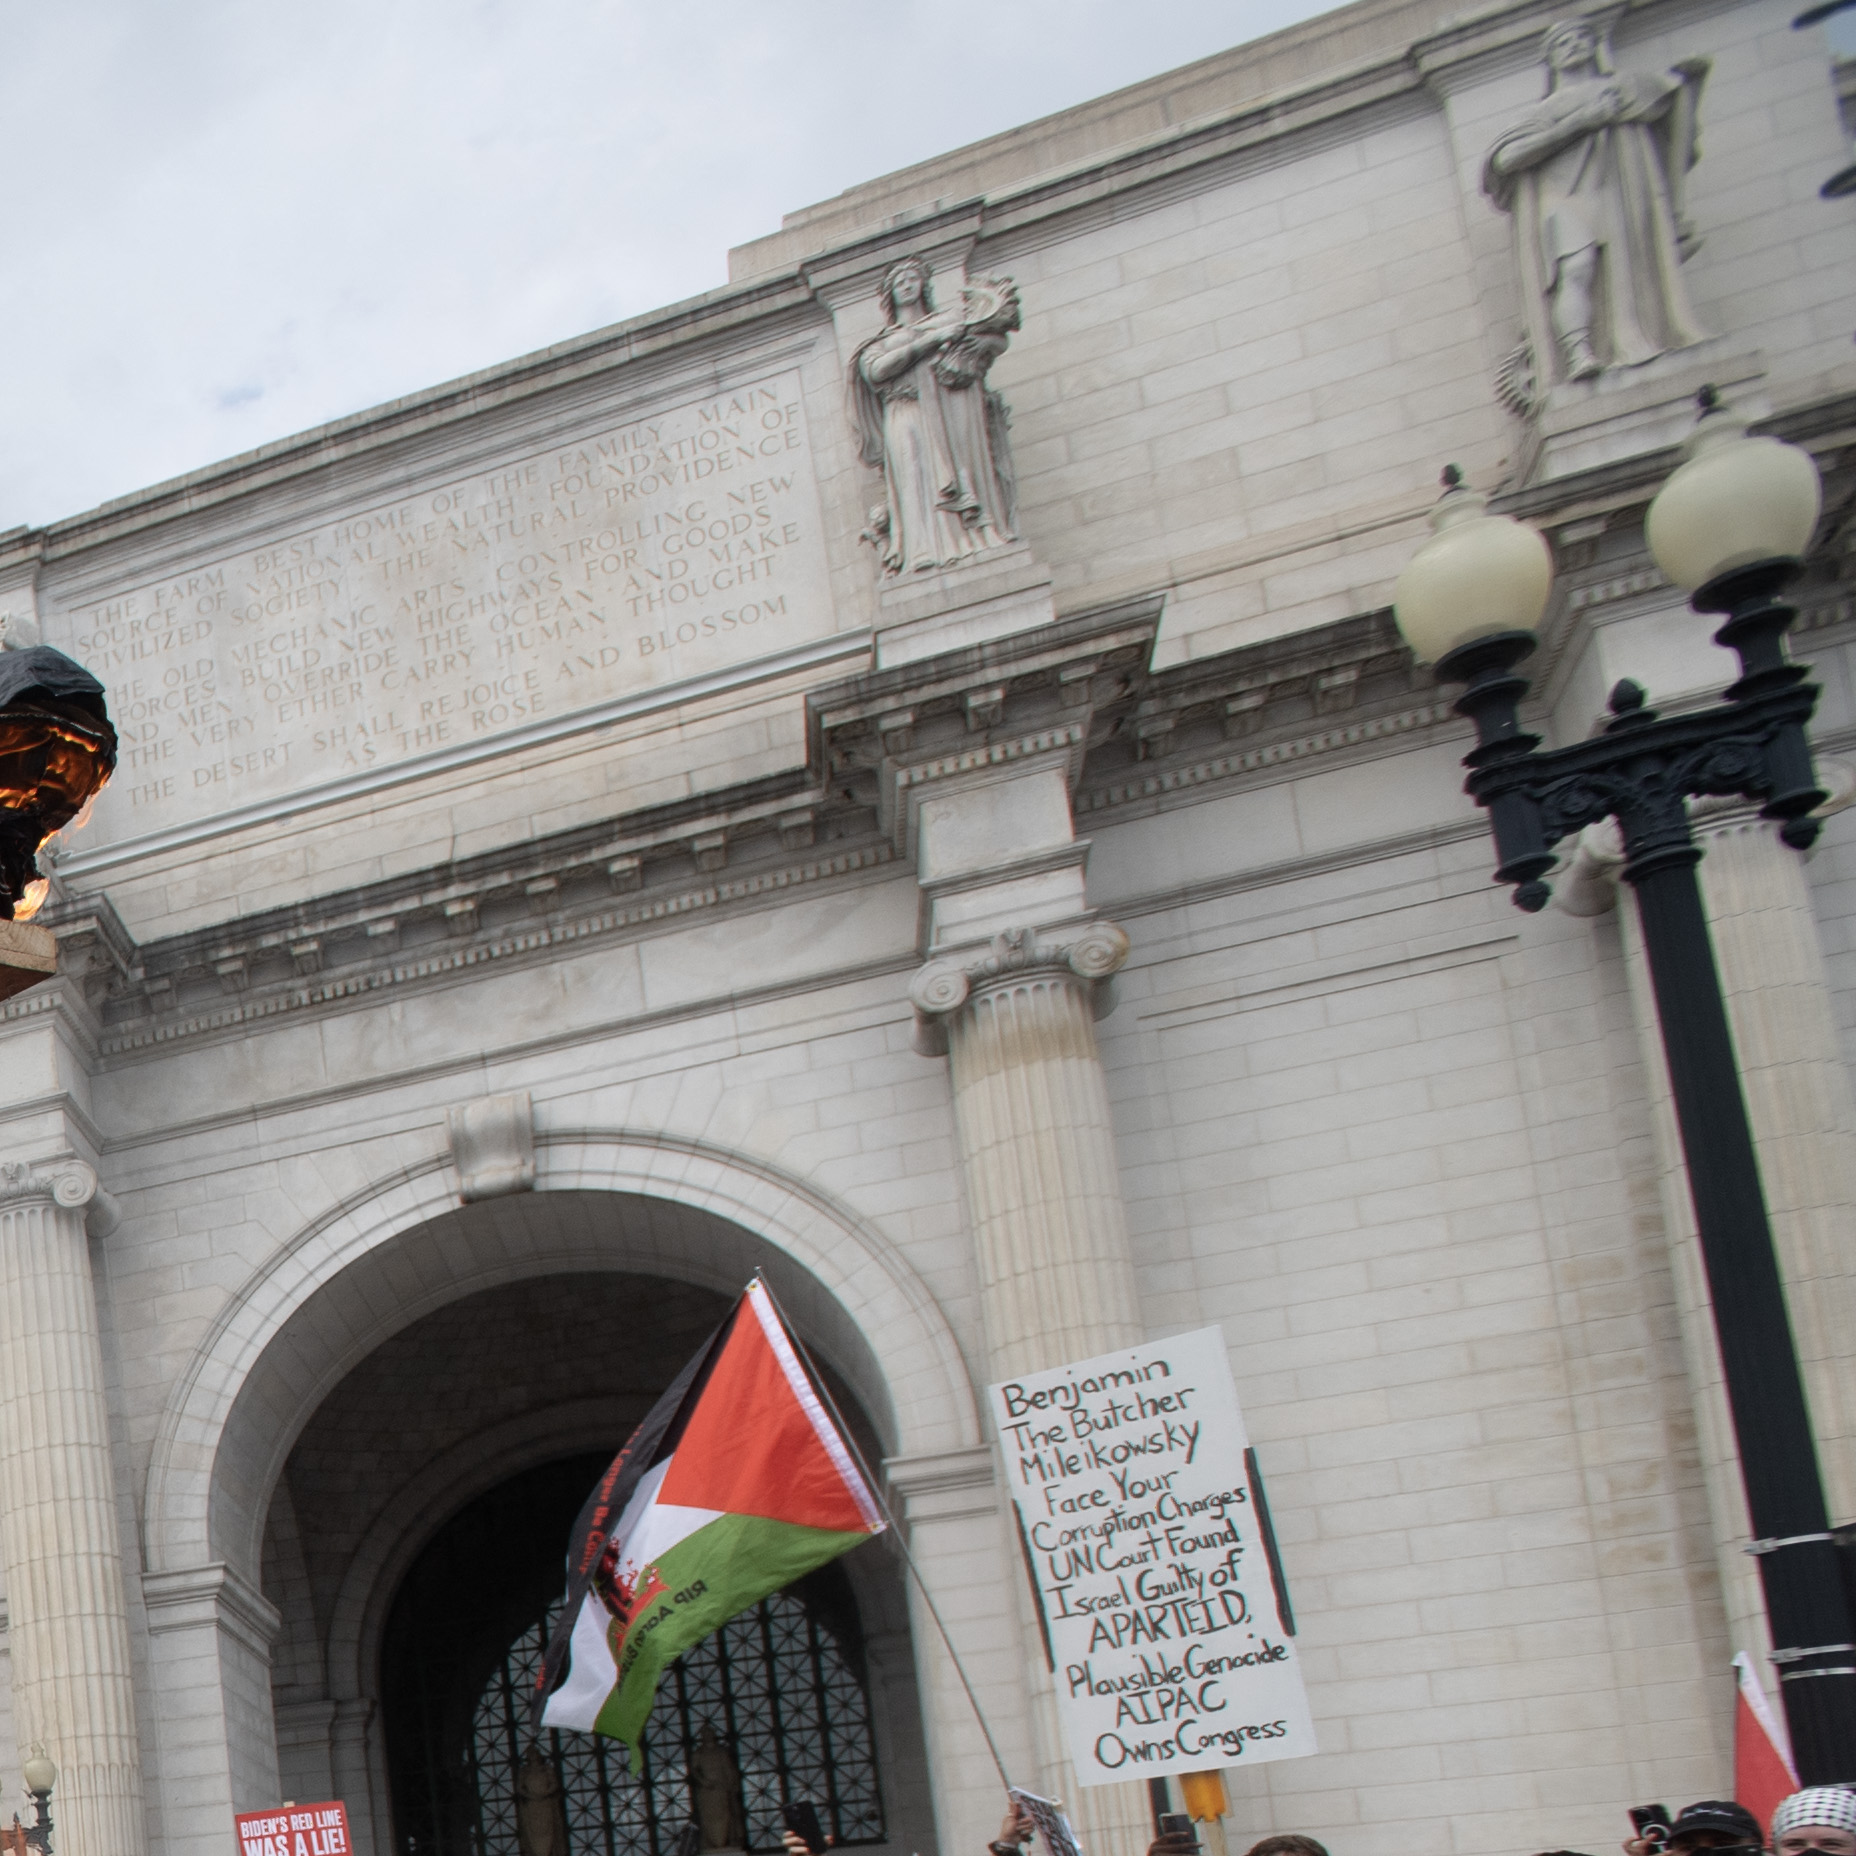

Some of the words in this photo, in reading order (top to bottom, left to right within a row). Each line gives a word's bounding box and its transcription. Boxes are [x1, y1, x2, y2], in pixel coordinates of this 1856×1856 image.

[77, 605, 179, 655] SOURCE
[195, 589, 229, 617] OF
[246, 539, 381, 599] NATIONAL
[395, 495, 515, 551] WEALTH
[548, 420, 742, 501] FOUNDATION
[760, 401, 801, 432] OF
[89, 597, 137, 628] THE
[153, 568, 225, 607] FARM
[252, 535, 321, 575] BEST
[333, 504, 414, 548] HOME
[431, 486, 467, 515] OF
[485, 463, 540, 497] THE
[557, 420, 666, 474] FAMILY
[696, 383, 779, 429] MAIN
[84, 616, 214, 675] CIVILIZED
[229, 574, 345, 629] SOCIETY
[377, 546, 434, 581] THE
[451, 496, 586, 557] NATURAL
[604, 426, 801, 507] PROVIDENCE
[111, 677, 145, 705] HE
[161, 655, 214, 689] OLD
[231, 603, 377, 666] MECHANIC
[393, 575, 466, 616] ARTS
[495, 498, 707, 583] CONTROLLING
[726, 469, 798, 511] NEW
[117, 677, 215, 726] FORCES
[240, 645, 321, 688] BUILD
[337, 622, 396, 657] NEW
[416, 569, 563, 632] HIGHWAYS
[584, 545, 640, 581] FOR
[660, 503, 772, 557] GOODS
[121, 719, 160, 748] ND
[175, 696, 234, 731] MEN
[262, 644, 401, 705] OVERRIDE
[416, 622, 472, 657] THE
[488, 584, 595, 635] OCEAN
[620, 555, 689, 595] AND
[708, 520, 800, 567] MAKE
[125, 737, 176, 769] THE
[190, 711, 259, 749] VERY
[277, 679, 364, 723] ETHER
[380, 645, 477, 692] CARRY
[494, 605, 607, 658] HUMAN
[625, 553, 777, 618] THOUGHT
[126, 775, 176, 808] THE
[192, 740, 296, 788] DESERT
[311, 707, 403, 753] SHALL
[419, 667, 539, 721] REJOICE
[554, 643, 621, 681] AND
[637, 593, 787, 657] BLOSSOM
[340, 740, 377, 769] AS
[396, 719, 451, 752] THE
[470, 691, 545, 732] ROSE
[1001, 1355, 1171, 1418] Benjamin
[1002, 1421, 1067, 1451] The
[1069, 1388, 1196, 1440] Butcher
[1019, 1420, 1200, 1485] Mileikowsky
[1031, 1504, 1158, 1551] Corruption
[1156, 1487, 1247, 1521] Charges
[1042, 1484, 1111, 1516] Face
[1110, 1467, 1179, 1501] Your
[1048, 1547, 1095, 1582] UN
[1164, 1518, 1241, 1558] Found
[1045, 1575, 1132, 1620] Israel
[1138, 1562, 1204, 1602] Guilty
[1209, 1548, 1245, 1587] of
[1066, 1651, 1187, 1698] Plausible
[1184, 1633, 1290, 1680] Genocide
[1115, 1680, 1227, 1729] AIPAC
[1095, 1732, 1175, 1769] Owns
[1175, 1718, 1288, 1757] Congress
[239, 1815, 289, 1839] BIDEN'S
[290, 1812, 314, 1831] RED
[315, 1809, 343, 1828] LINE
[310, 1828, 347, 1856] LIE!
